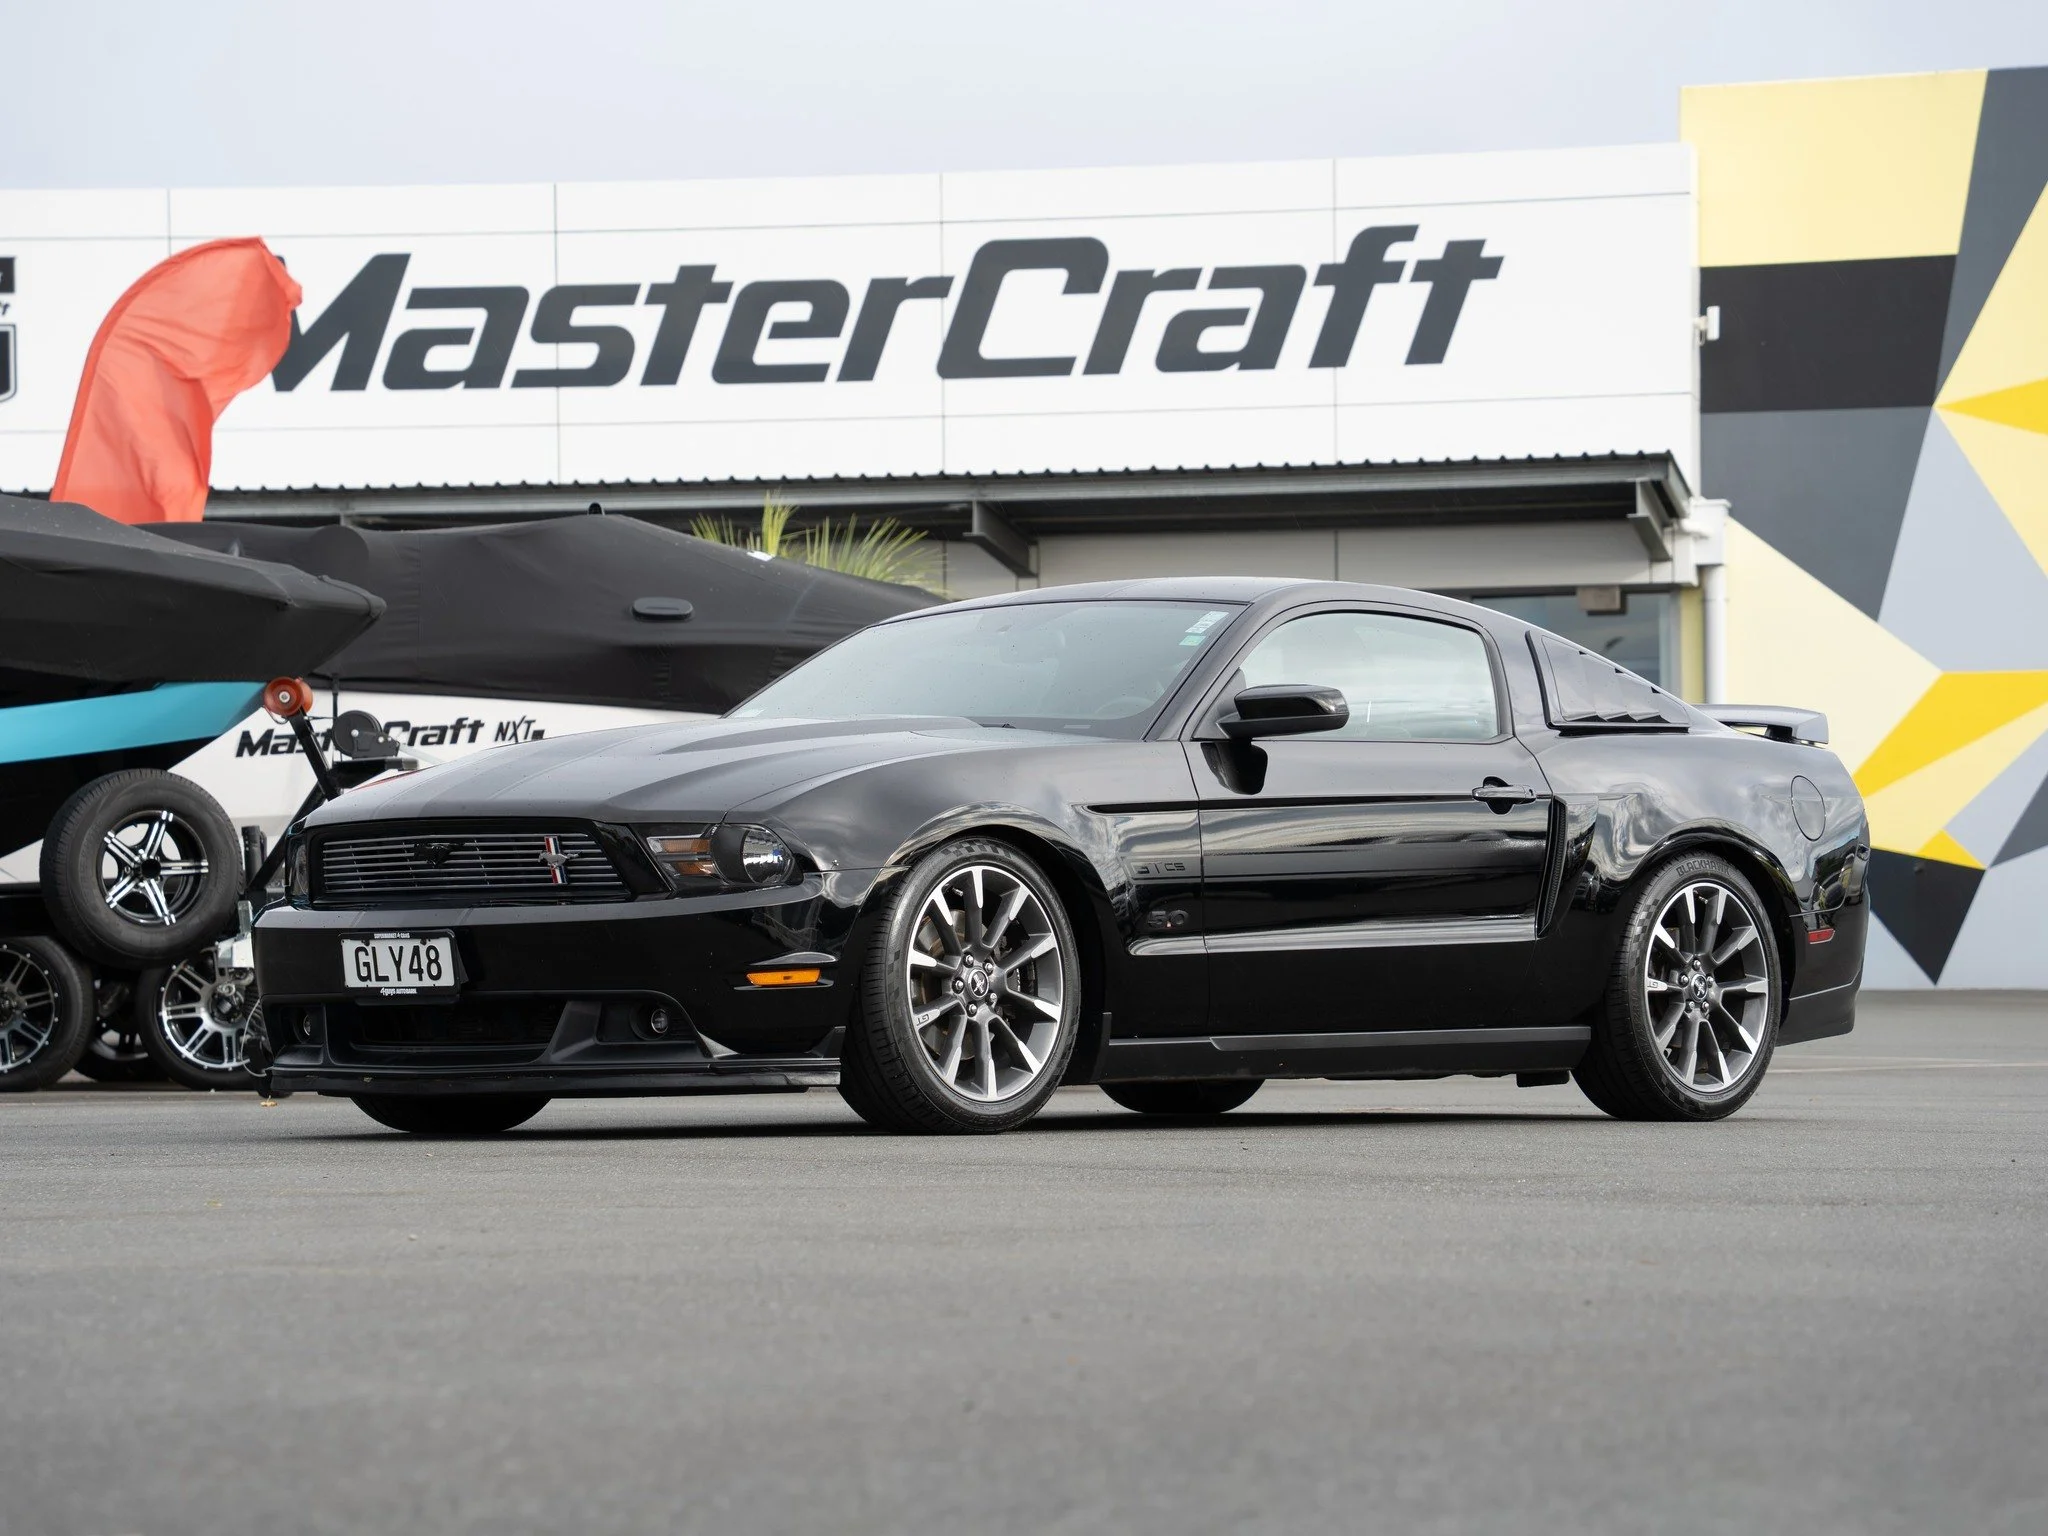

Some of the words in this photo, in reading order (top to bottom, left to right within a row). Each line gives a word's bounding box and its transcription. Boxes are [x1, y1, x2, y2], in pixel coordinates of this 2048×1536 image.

[494, 715, 536, 743] NXT
[1147, 910, 1189, 929] 5.0
[354, 945, 442, 982] GLY48
